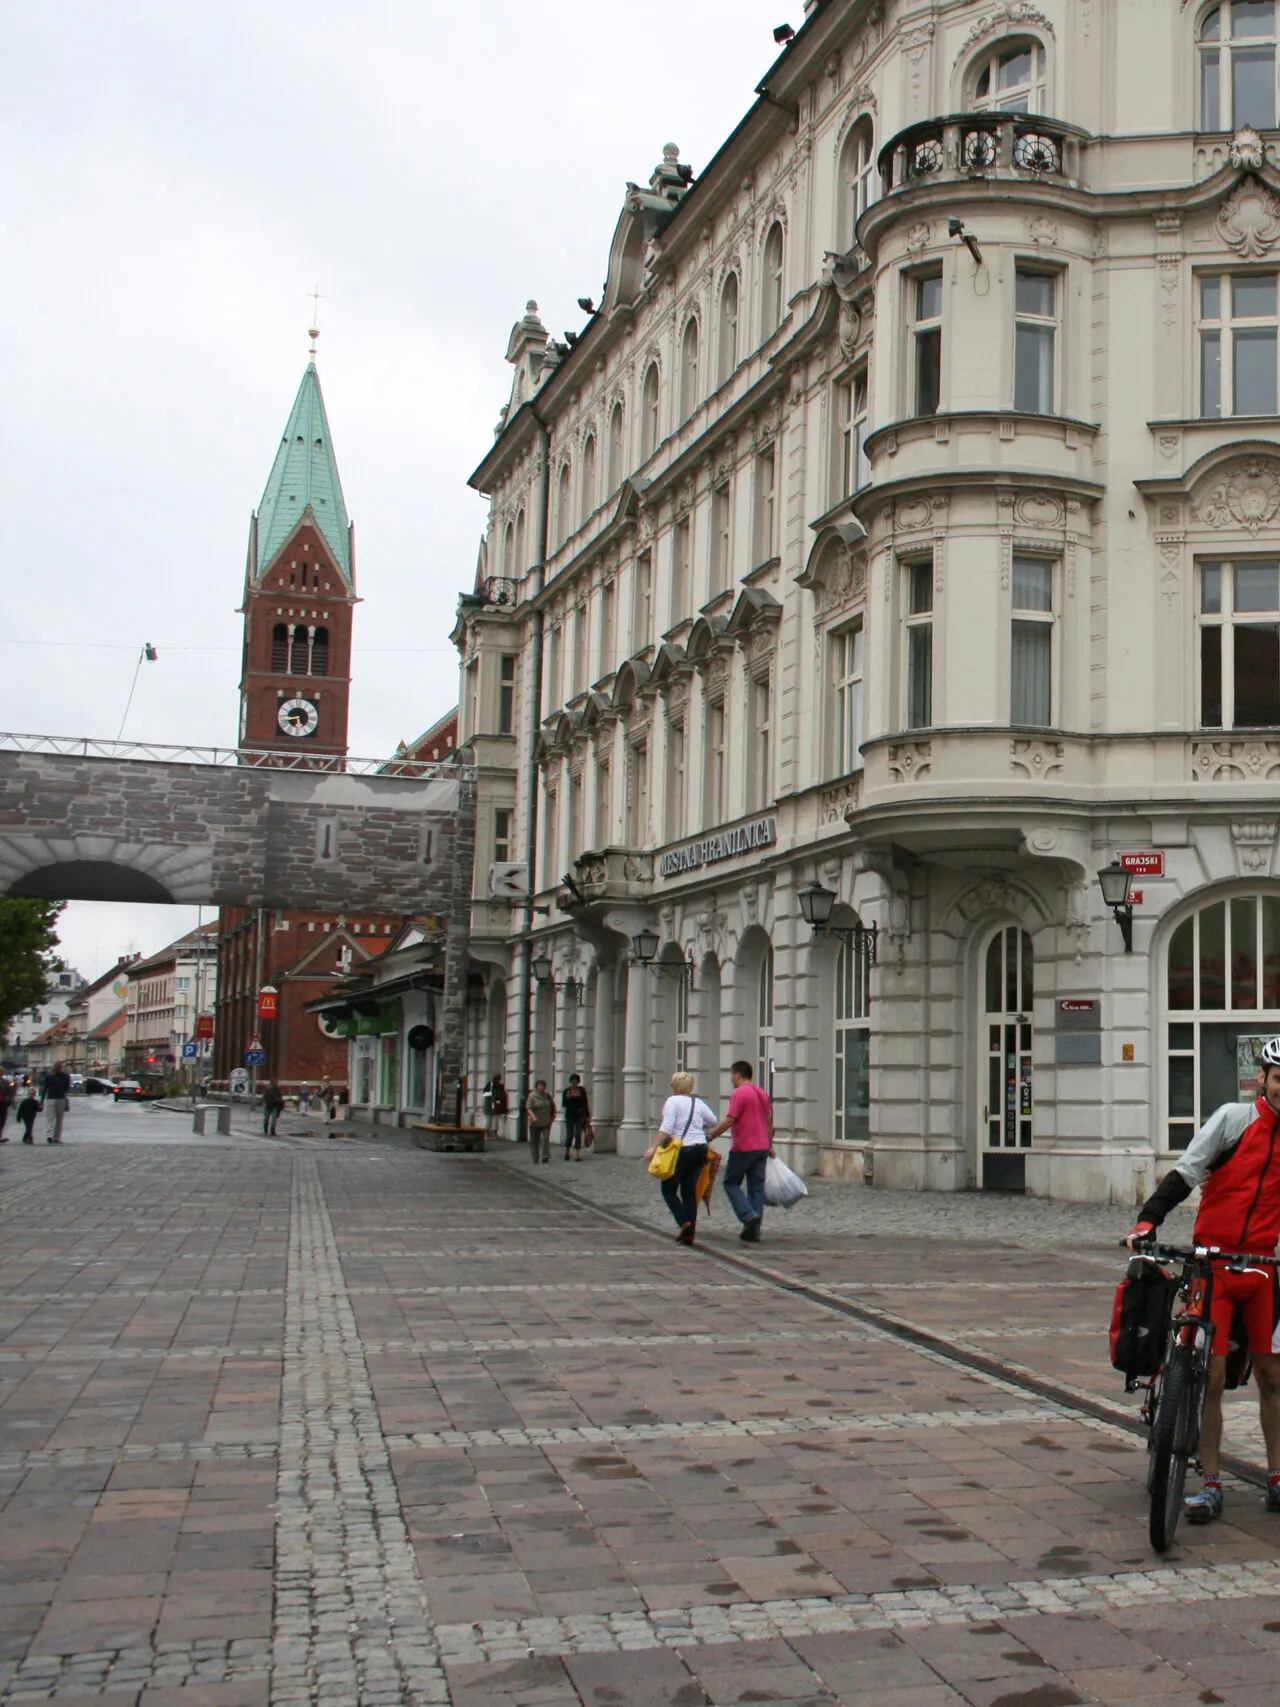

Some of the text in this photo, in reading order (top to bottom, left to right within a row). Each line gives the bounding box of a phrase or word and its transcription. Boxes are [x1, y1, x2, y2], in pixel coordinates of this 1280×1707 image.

[660, 820, 771, 875] MESTNA HRANILNICA
[1125, 857, 1158, 865] GRAJSKI
[185, 1046, 193, 1056] P
